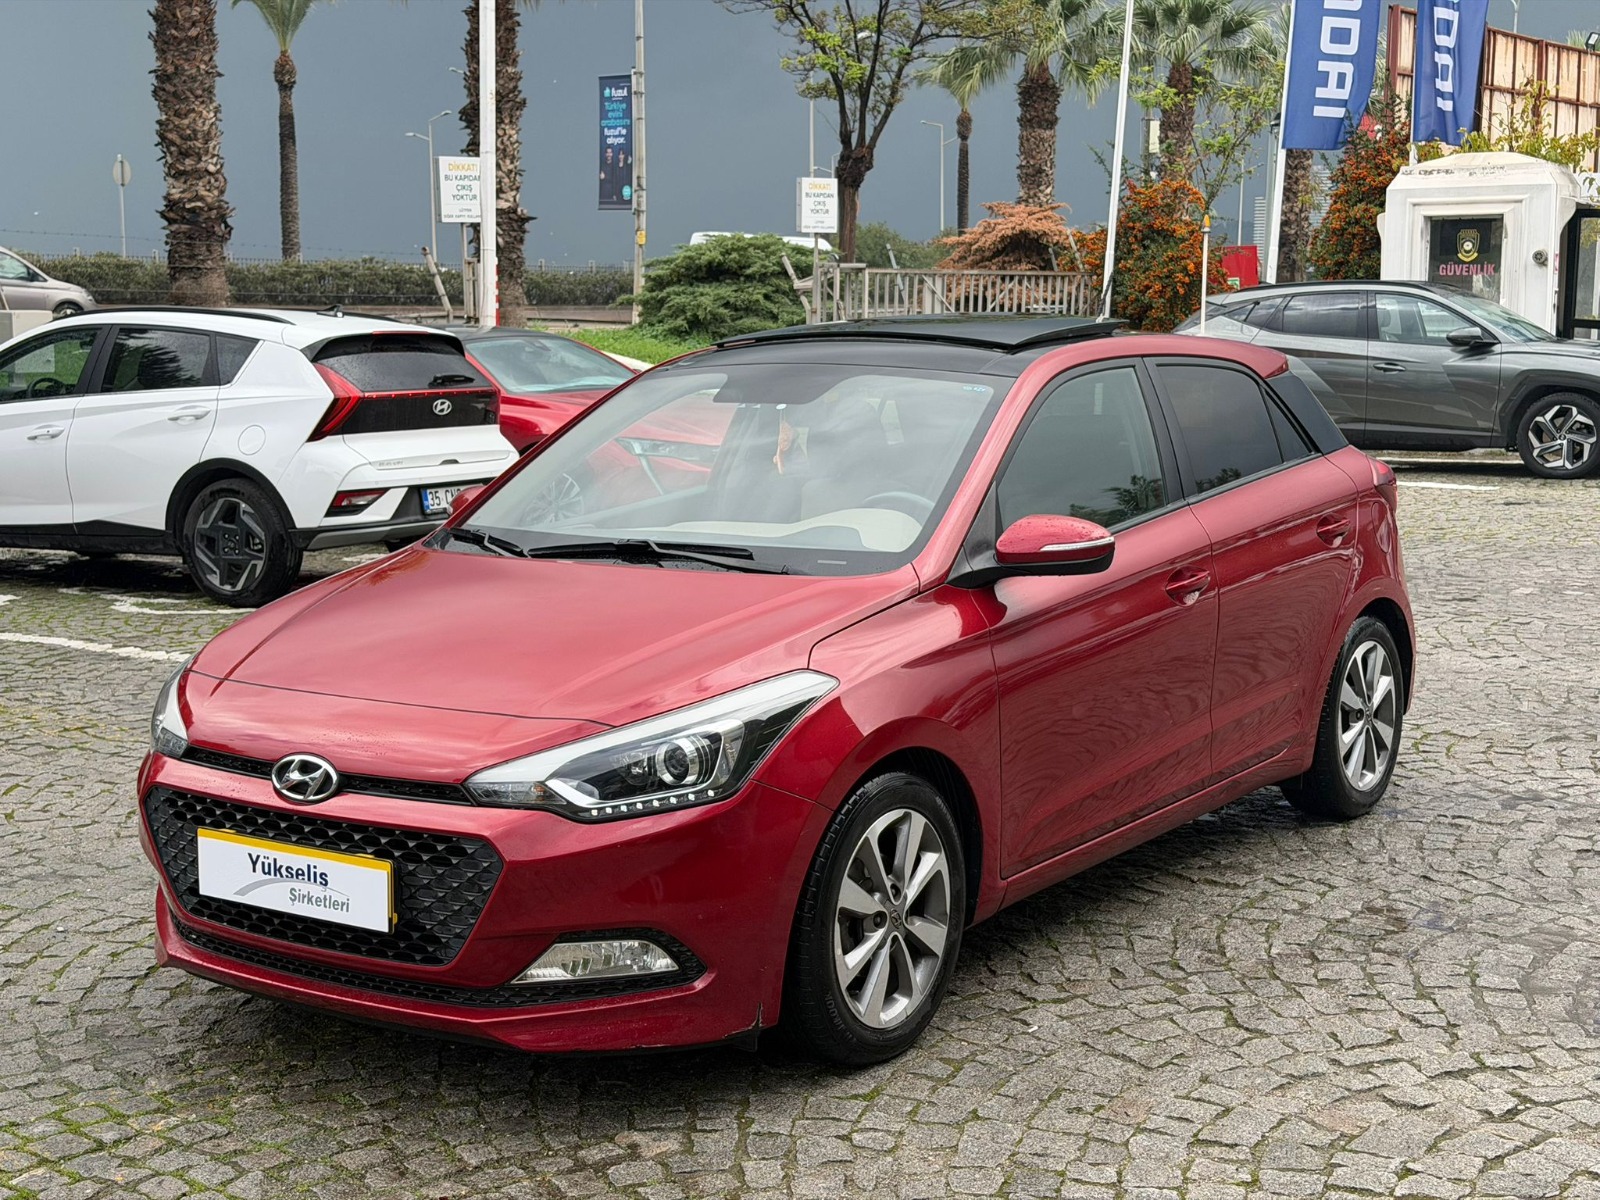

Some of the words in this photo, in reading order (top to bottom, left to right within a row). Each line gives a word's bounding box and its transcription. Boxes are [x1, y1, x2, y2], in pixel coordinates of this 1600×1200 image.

[1434, 2, 1459, 111] DAI
[611, 86, 628, 97] fuzul
[604, 102, 627, 111] Türkiye
[455, 184, 473, 193] ÇIKIŞ
[813, 200, 827, 208] ÇIKIŞ
[1439, 261, 1495, 276] GÜVENLİK
[428, 490, 441, 507] 35
[247, 852, 330, 889] Yükseliş
[289, 887, 350, 913] Şirketleri
